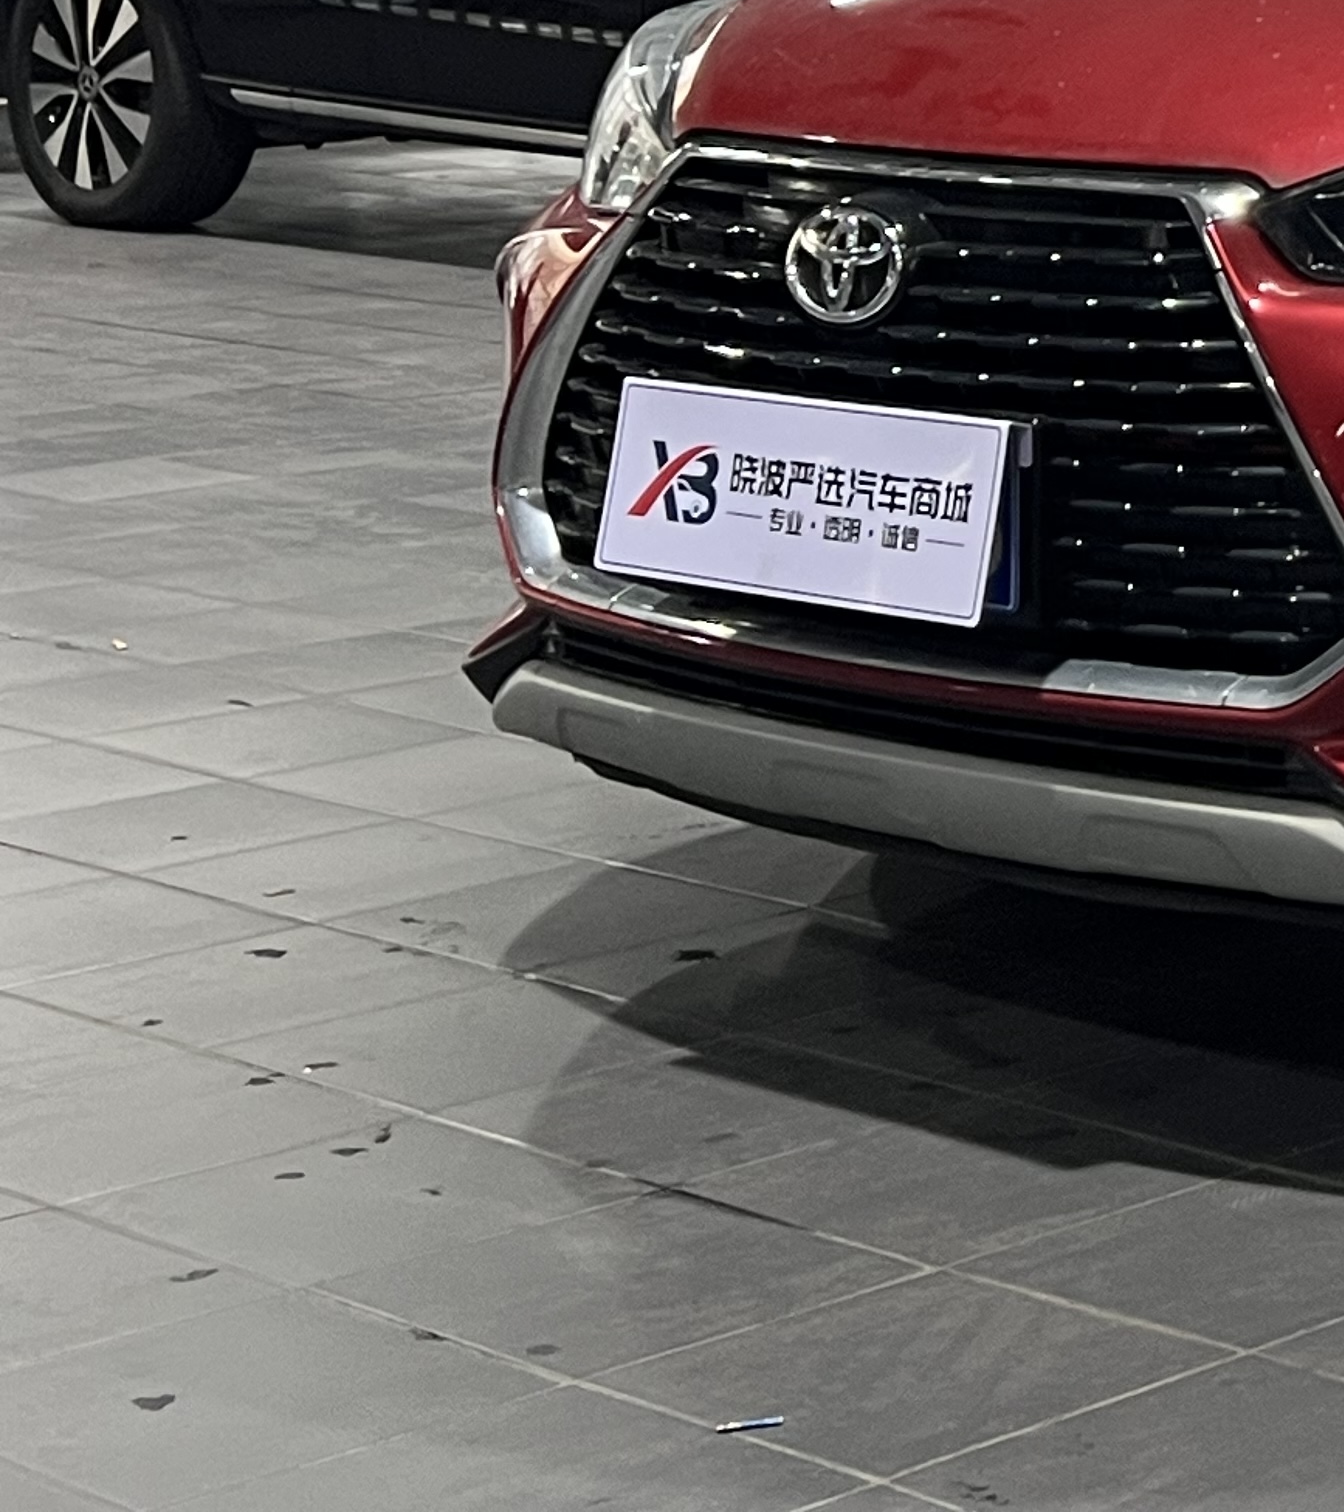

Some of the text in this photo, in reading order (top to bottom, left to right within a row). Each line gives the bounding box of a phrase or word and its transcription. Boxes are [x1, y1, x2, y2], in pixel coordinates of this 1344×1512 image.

[729, 453, 974, 523] 晓波严选汽车商城
